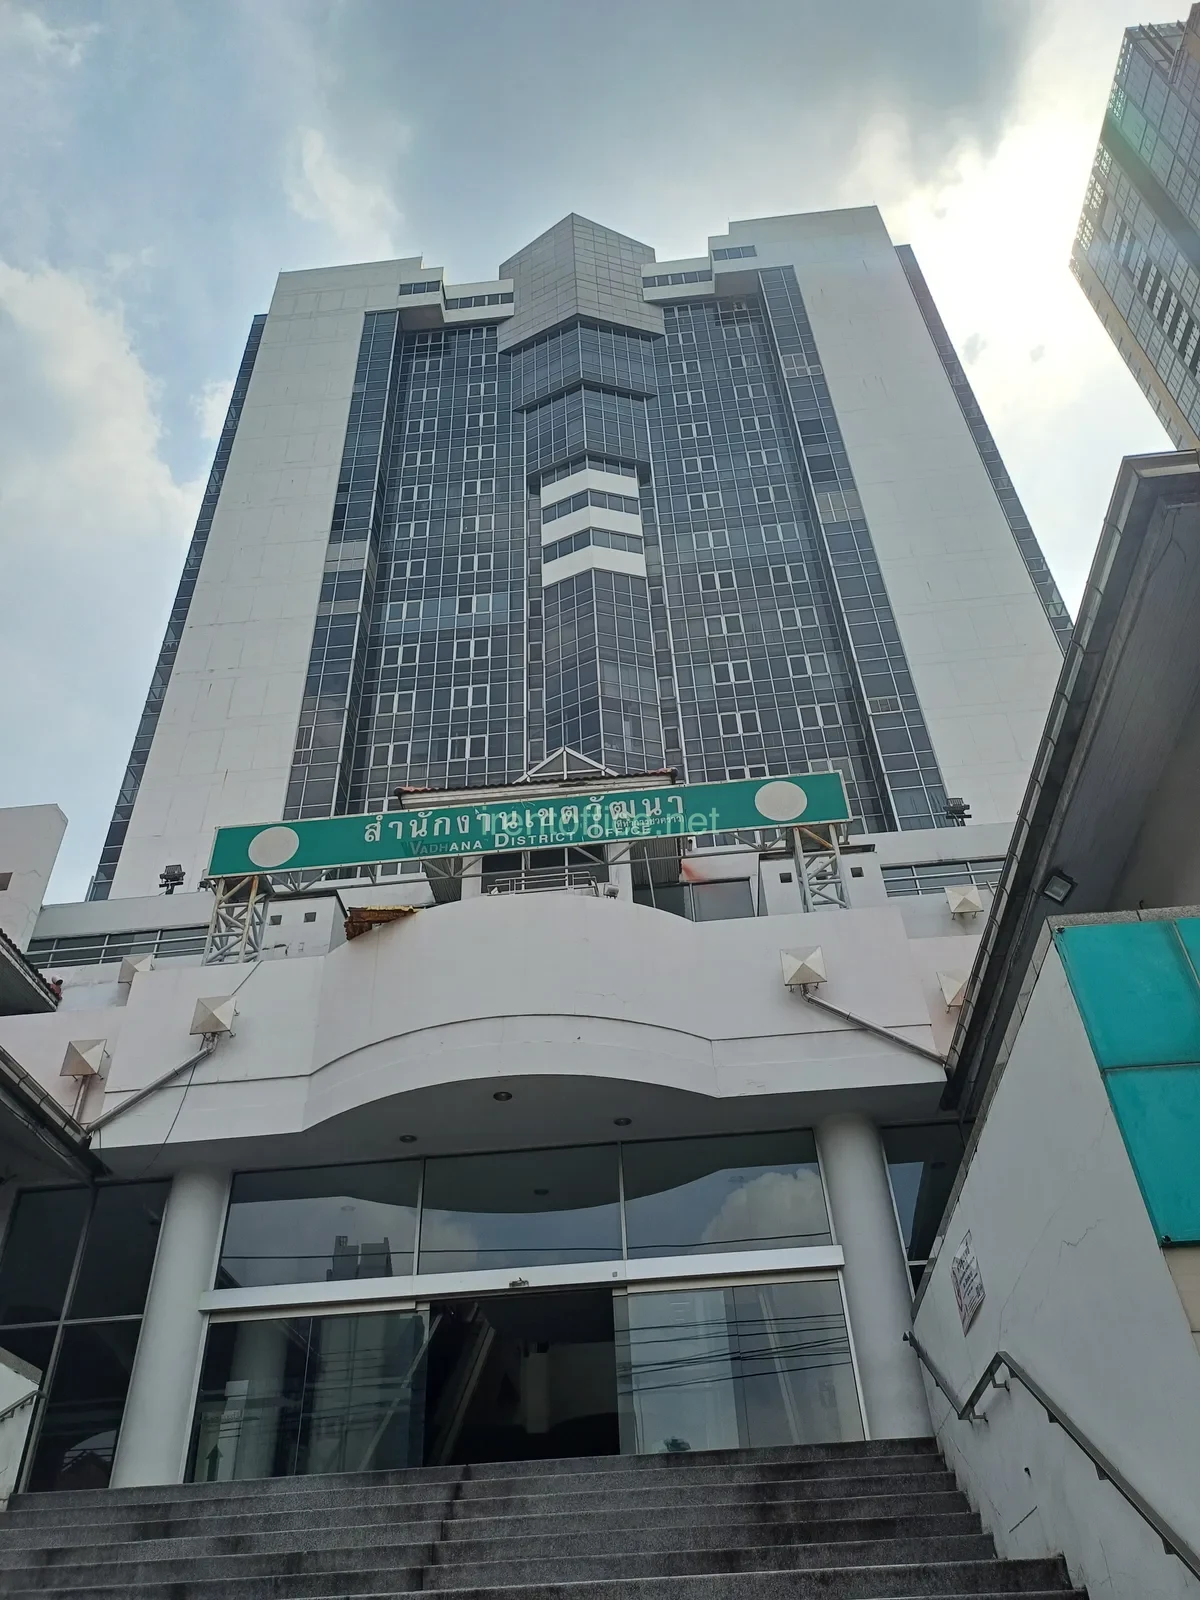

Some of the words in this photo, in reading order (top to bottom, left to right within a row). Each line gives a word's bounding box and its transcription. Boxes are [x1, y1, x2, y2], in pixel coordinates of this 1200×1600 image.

[363, 794, 685, 842] สำนักงานเขตวัฒนา
[409, 840, 483, 856] VADHANA
[494, 831, 576, 848] DISTRICT
[586, 823, 651, 839] OFFICE
